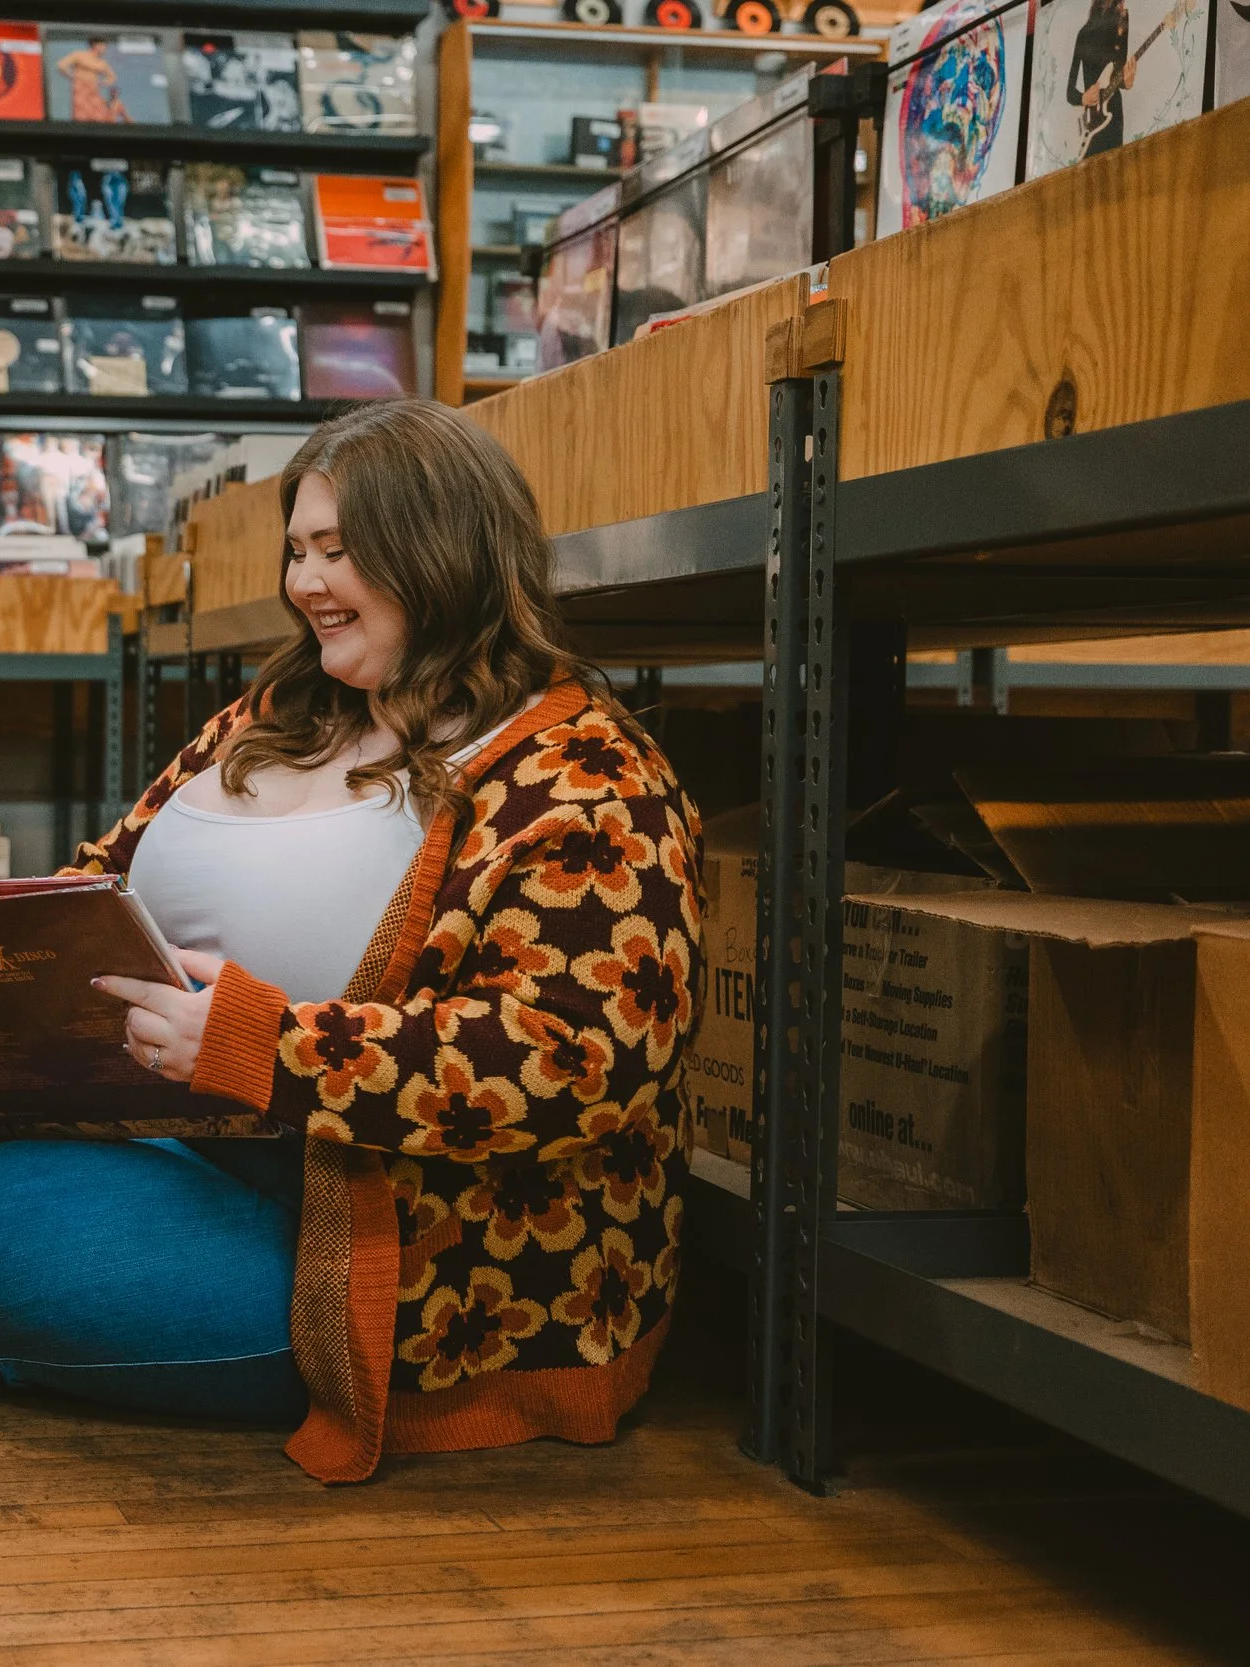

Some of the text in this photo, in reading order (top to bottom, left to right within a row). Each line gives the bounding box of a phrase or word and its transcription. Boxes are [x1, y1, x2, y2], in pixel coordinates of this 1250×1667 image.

[13, 949, 57, 962] DISCO
[725, 926, 756, 963] Box
[900, 948, 929, 969] Trailer
[882, 979, 912, 1004] Moving
[913, 986, 954, 1010] Supplies
[852, 1008, 899, 1036] Self-Storage
[900, 1019, 938, 1042] Location
[703, 1057, 745, 1086] GOODS
[846, 1039, 864, 1058] Your
[865, 1044, 895, 1067] Nearest
[928, 1059, 969, 1085] Location
[849, 1100, 933, 1153] online at...
